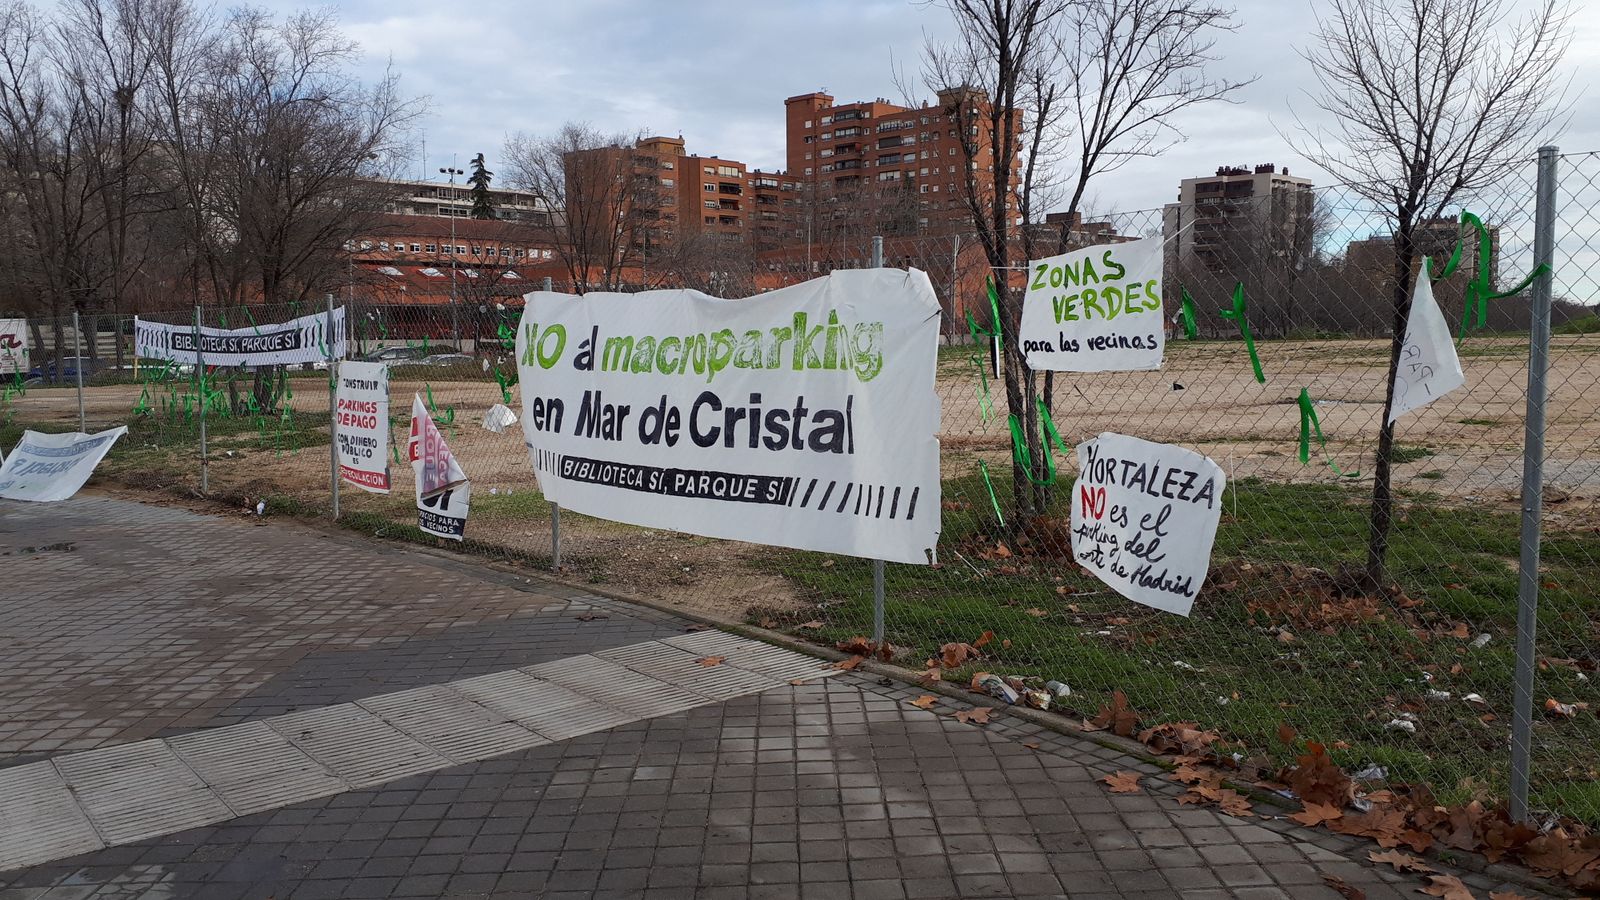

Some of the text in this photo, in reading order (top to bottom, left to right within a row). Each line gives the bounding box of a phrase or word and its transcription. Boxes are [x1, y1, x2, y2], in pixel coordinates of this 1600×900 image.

[1031, 250, 1126, 291] ZONAS
[1052, 279, 1161, 324] VERDES
[175, 335, 228, 351] BIBLOTECA
[242, 334, 283, 351] PARQUE
[522, 309, 883, 383] NO al macroparking
[1023, 339, 1055, 359] para
[1060, 331, 1080, 352] las
[338, 398, 378, 414] PARKINGS
[351, 414, 377, 430] PAGO
[532, 390, 854, 454] en Mar de Cristal
[338, 433, 377, 449] CON DINERO
[563, 459, 643, 487] BIBLIOTECA
[674, 474, 759, 499] PARQUE
[1081, 445, 1215, 509] HORTALEZA
[427, 520, 454, 534] VECINOS
[439, 516, 460, 527] PARA
[1081, 484, 1172, 537] NO es el
[1125, 531, 1166, 563] del
[1111, 551, 1130, 578] de
[1130, 564, 1193, 598] Madrid
